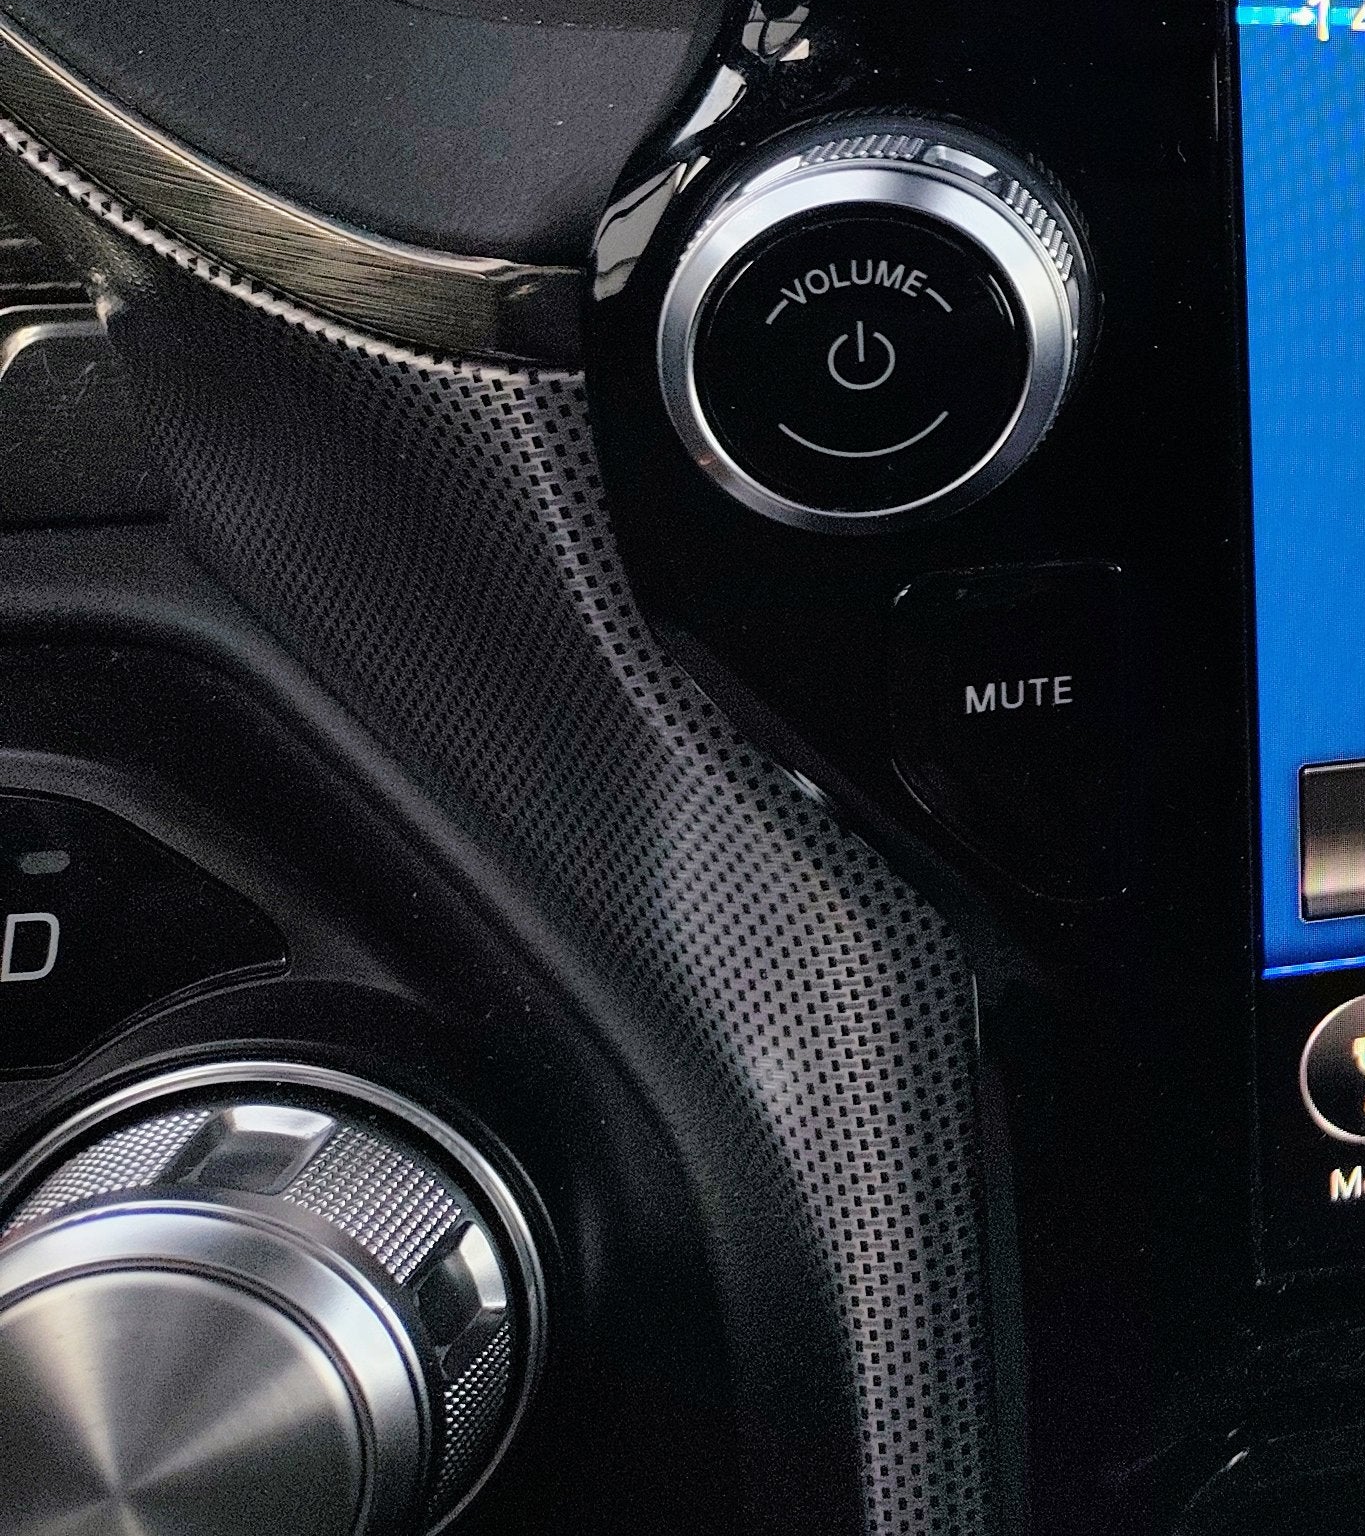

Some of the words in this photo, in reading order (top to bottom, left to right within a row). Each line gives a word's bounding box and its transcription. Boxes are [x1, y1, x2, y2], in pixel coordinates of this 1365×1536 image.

[782, 259, 928, 305] VOLUME
[965, 676, 1073, 715] MUTE
[0, 912, 60, 982] D
